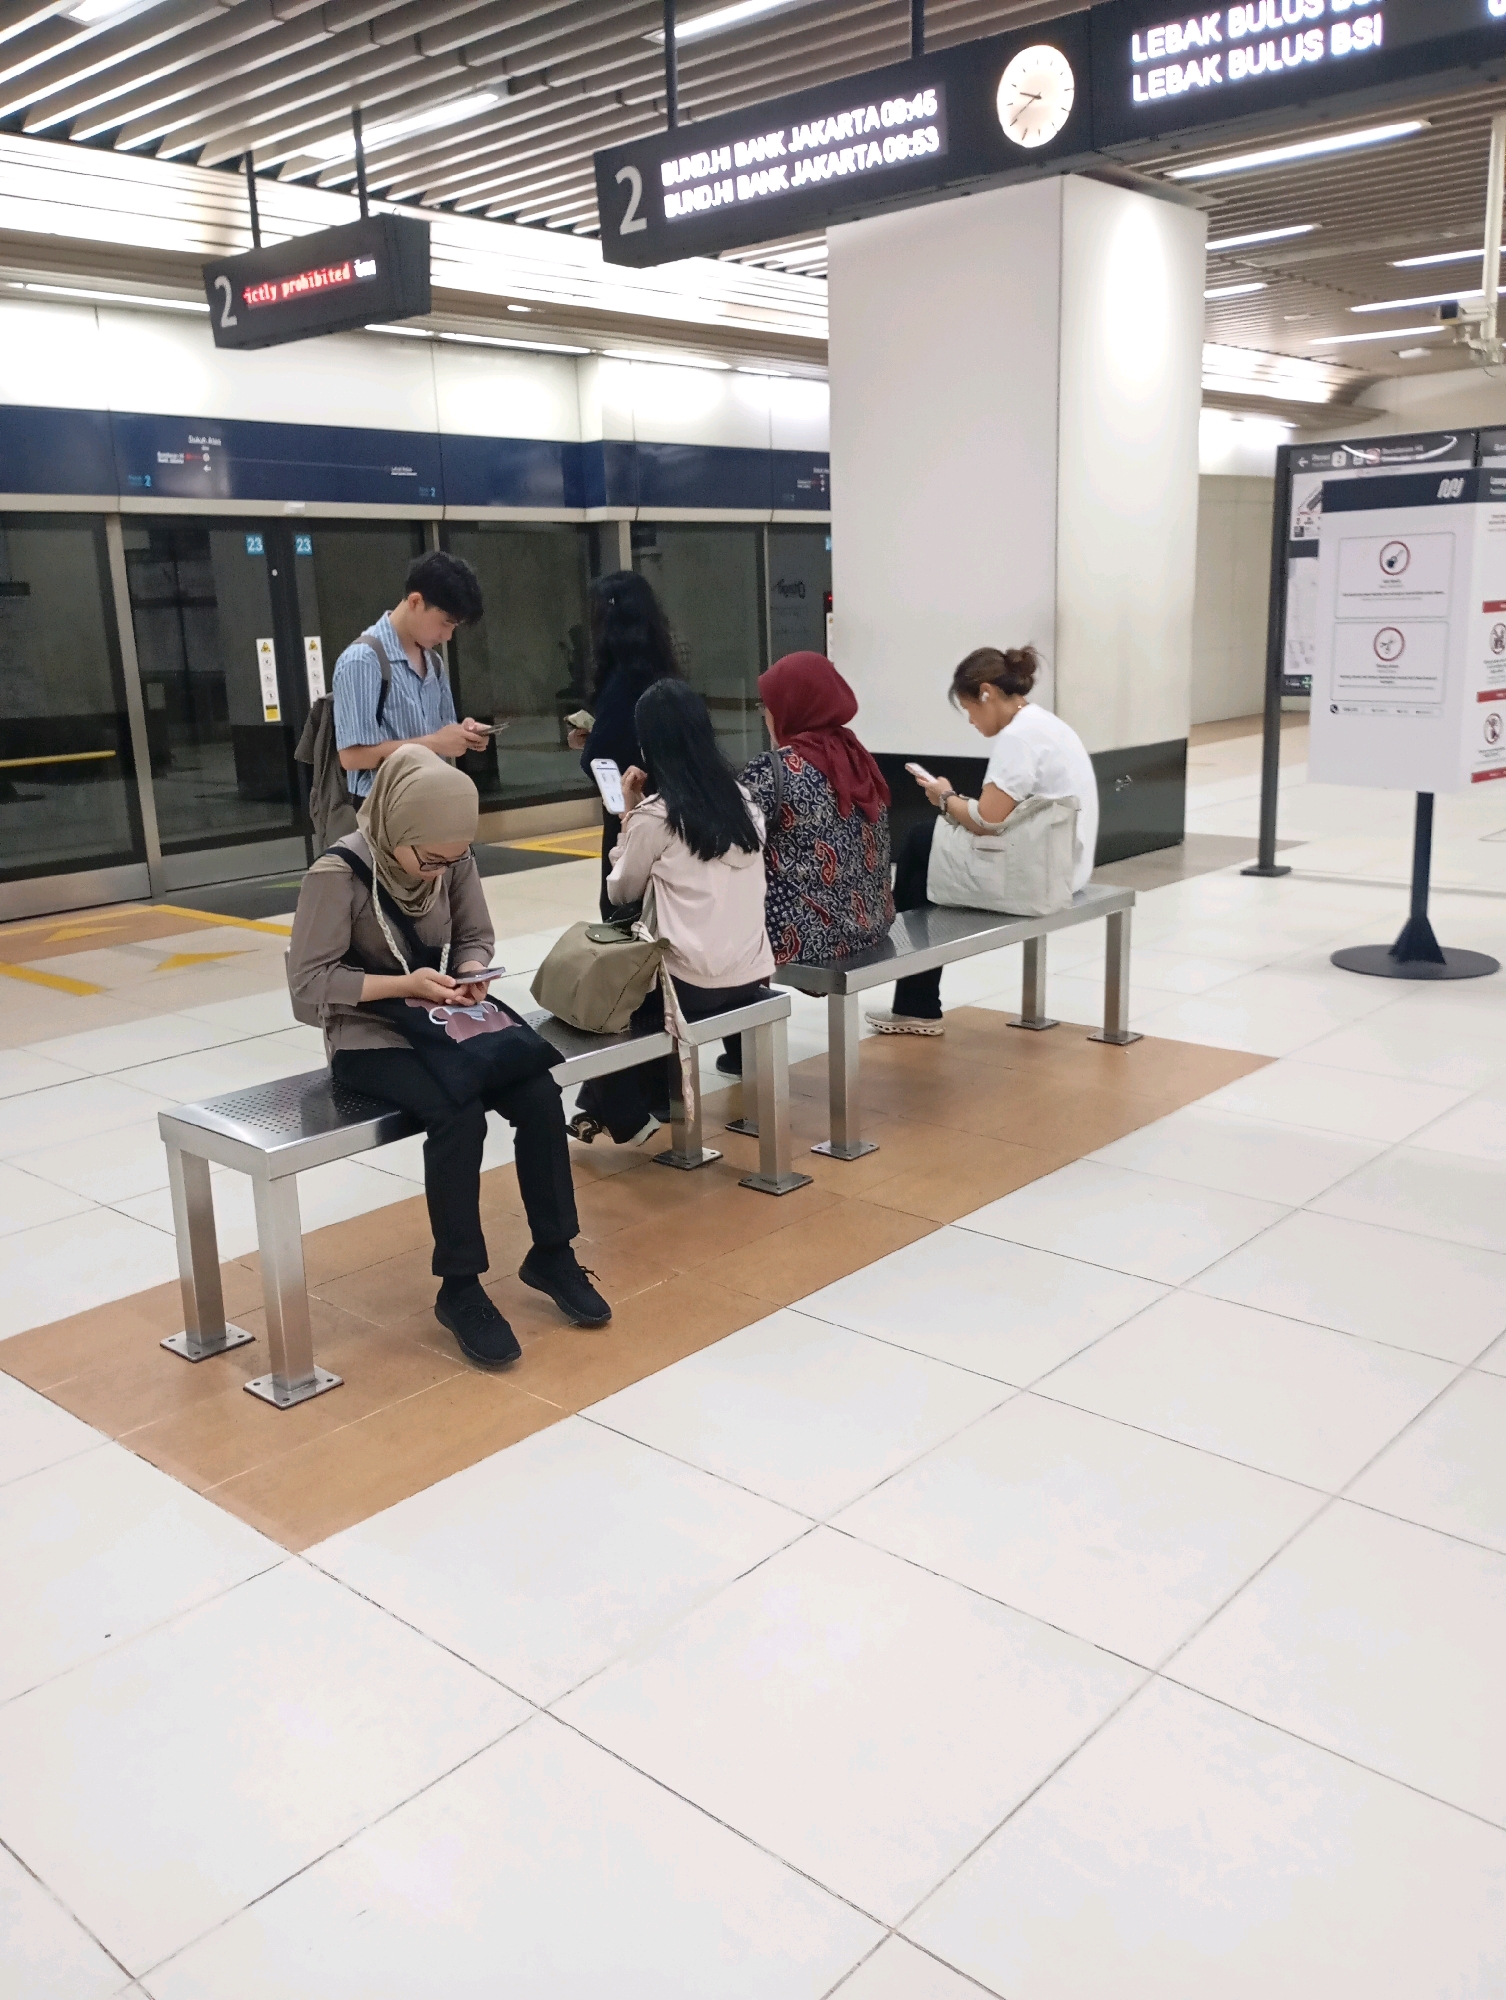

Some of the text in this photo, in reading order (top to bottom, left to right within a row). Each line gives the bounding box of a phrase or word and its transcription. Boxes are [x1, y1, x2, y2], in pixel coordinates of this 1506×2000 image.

[1132, 12, 1222, 62] LEBAK
[1132, 12, 1382, 102] LEBAK BULUS BSI
[735, 131, 787, 168] BANK
[788, 106, 880, 153] JAKARTA
[737, 165, 789, 200] BANK
[790, 141, 883, 187] JAKARTA
[615, 165, 648, 235] 2
[214, 275, 238, 328] 2
[282, 264, 351, 297] prohibited
[247, 536, 263, 552] 23
[296, 536, 312, 552] 23
